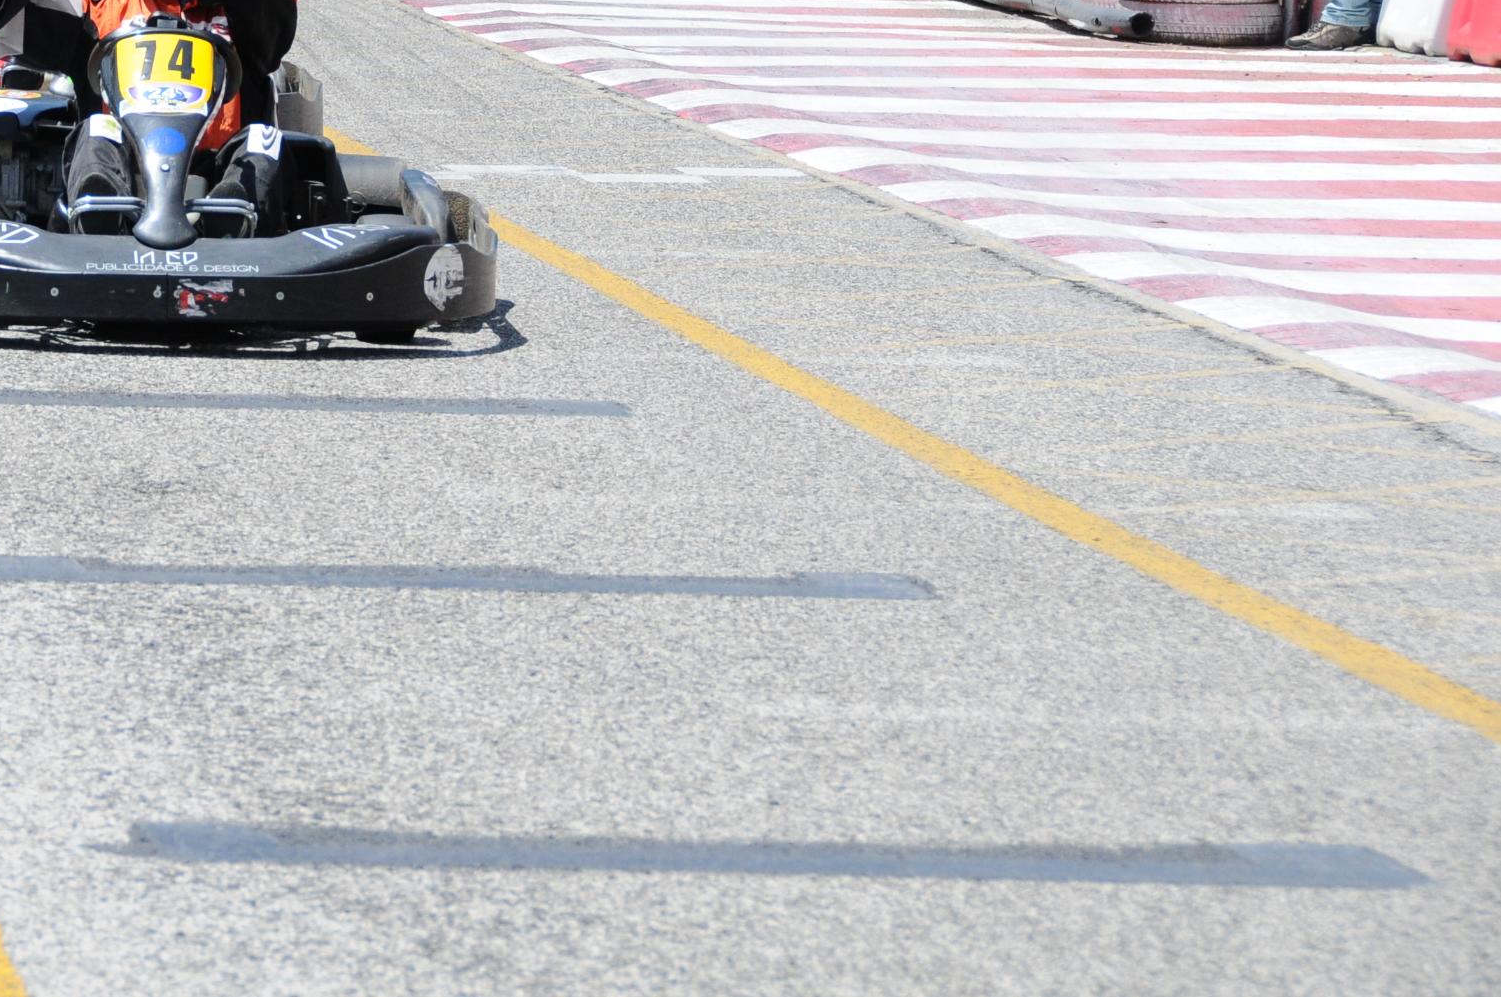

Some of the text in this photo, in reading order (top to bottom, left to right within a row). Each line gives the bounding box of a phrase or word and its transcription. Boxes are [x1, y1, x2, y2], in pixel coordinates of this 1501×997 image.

[135, 39, 196, 81] 74
[85, 263, 184, 272] PUBLICIDADE
[203, 265, 260, 273] DESIGN
